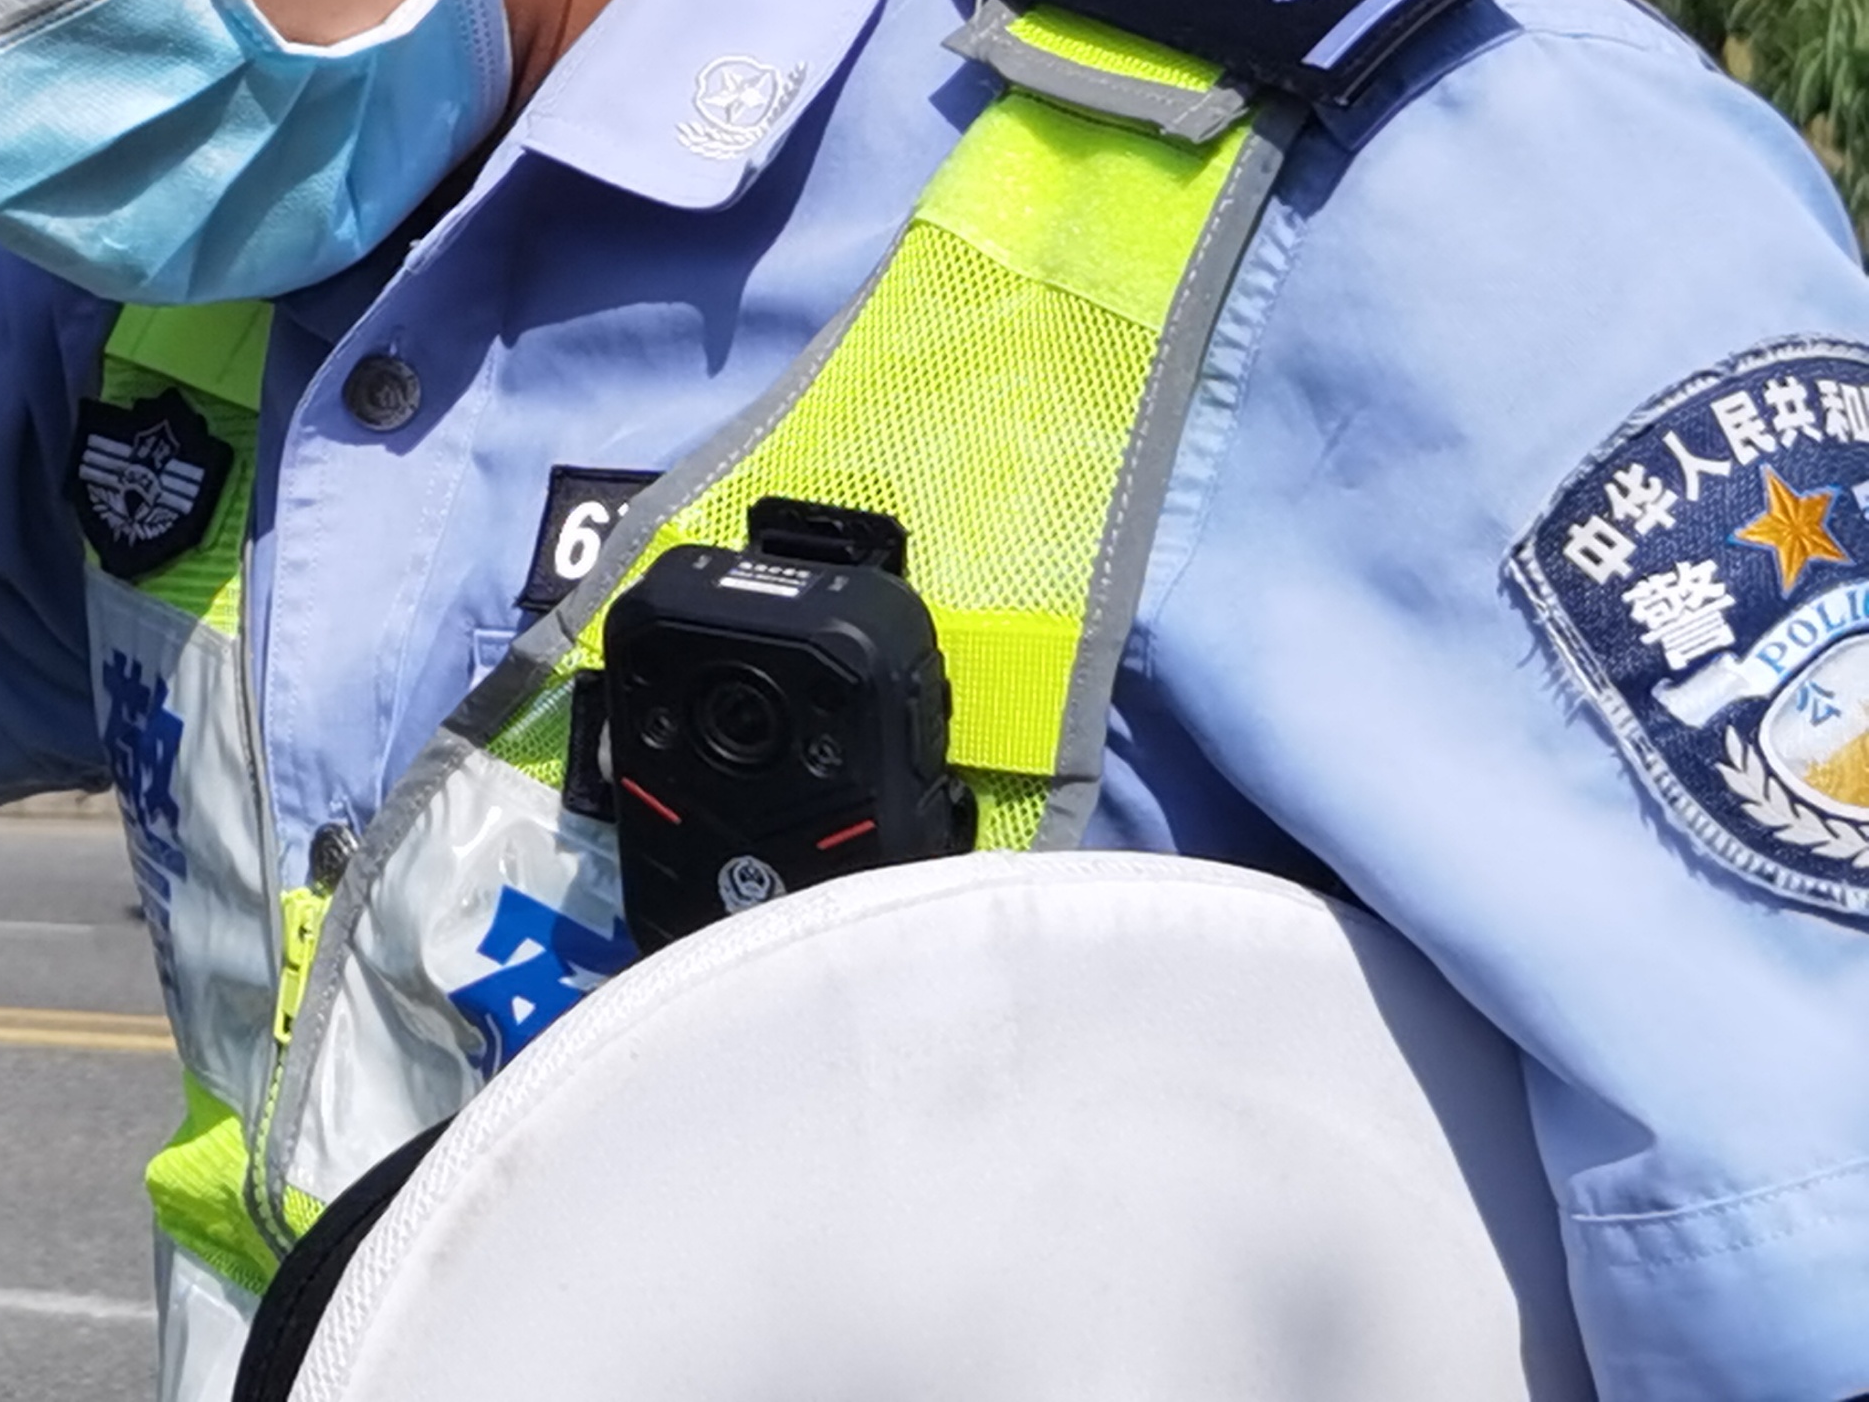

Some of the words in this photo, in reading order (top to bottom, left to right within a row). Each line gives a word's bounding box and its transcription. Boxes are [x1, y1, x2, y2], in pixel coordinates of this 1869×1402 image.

[555, 501, 630, 580] 6
[1623, 558, 1735, 671] 警
[1758, 588, 1869, 676] POLI
[1795, 679, 1843, 727] 公
